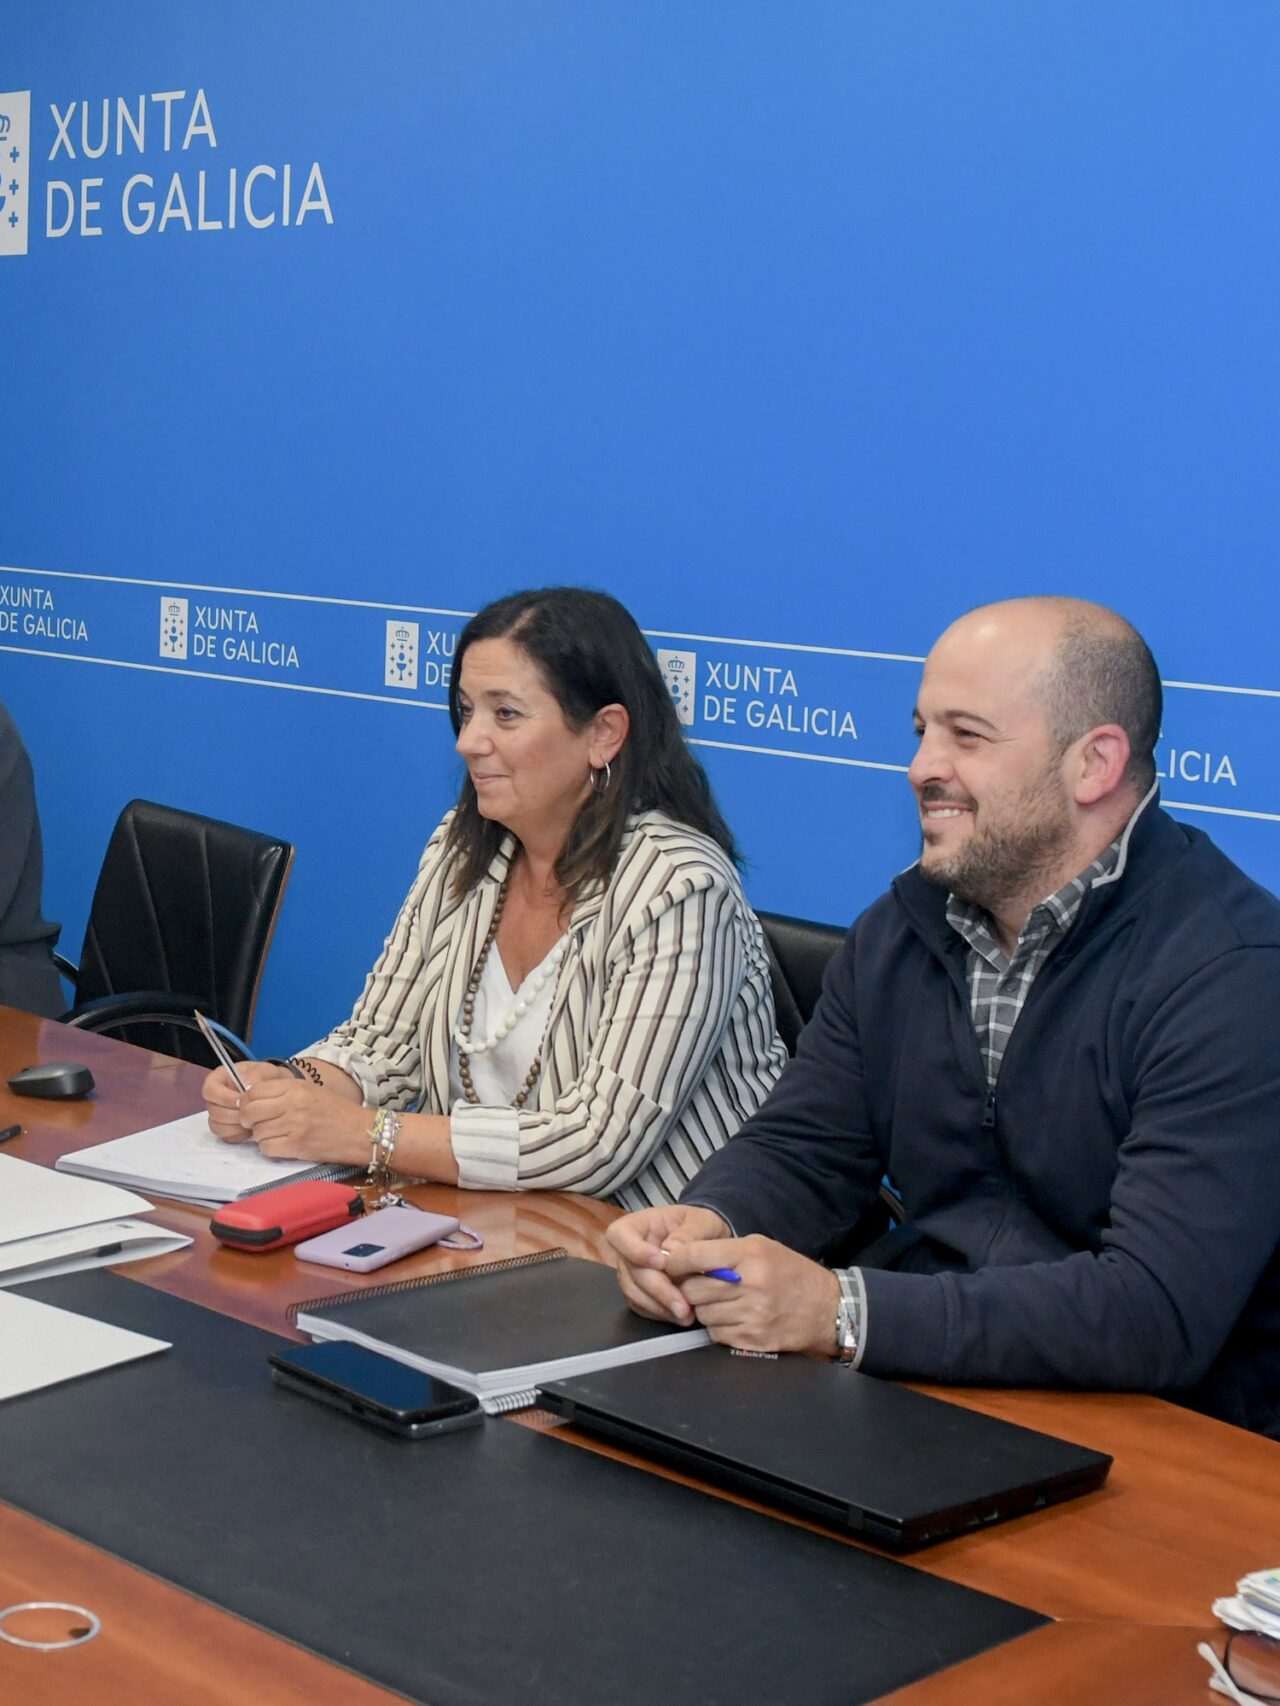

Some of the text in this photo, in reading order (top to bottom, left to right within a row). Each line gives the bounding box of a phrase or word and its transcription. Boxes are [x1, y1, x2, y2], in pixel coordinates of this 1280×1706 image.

[48, 88, 217, 161] XUNTA
[46, 161, 335, 238] DE GALICIA
[0, 585, 55, 611] XUNTA
[23, 613, 89, 642] GALICIA
[194, 606, 260, 635] XUNTA
[193, 633, 300, 669] DE GALICIA
[425, 661, 453, 688] DE
[705, 661, 799, 697] XUNTA
[703, 695, 858, 740] DE GALICIA
[1156, 748, 1238, 787] ICIA
